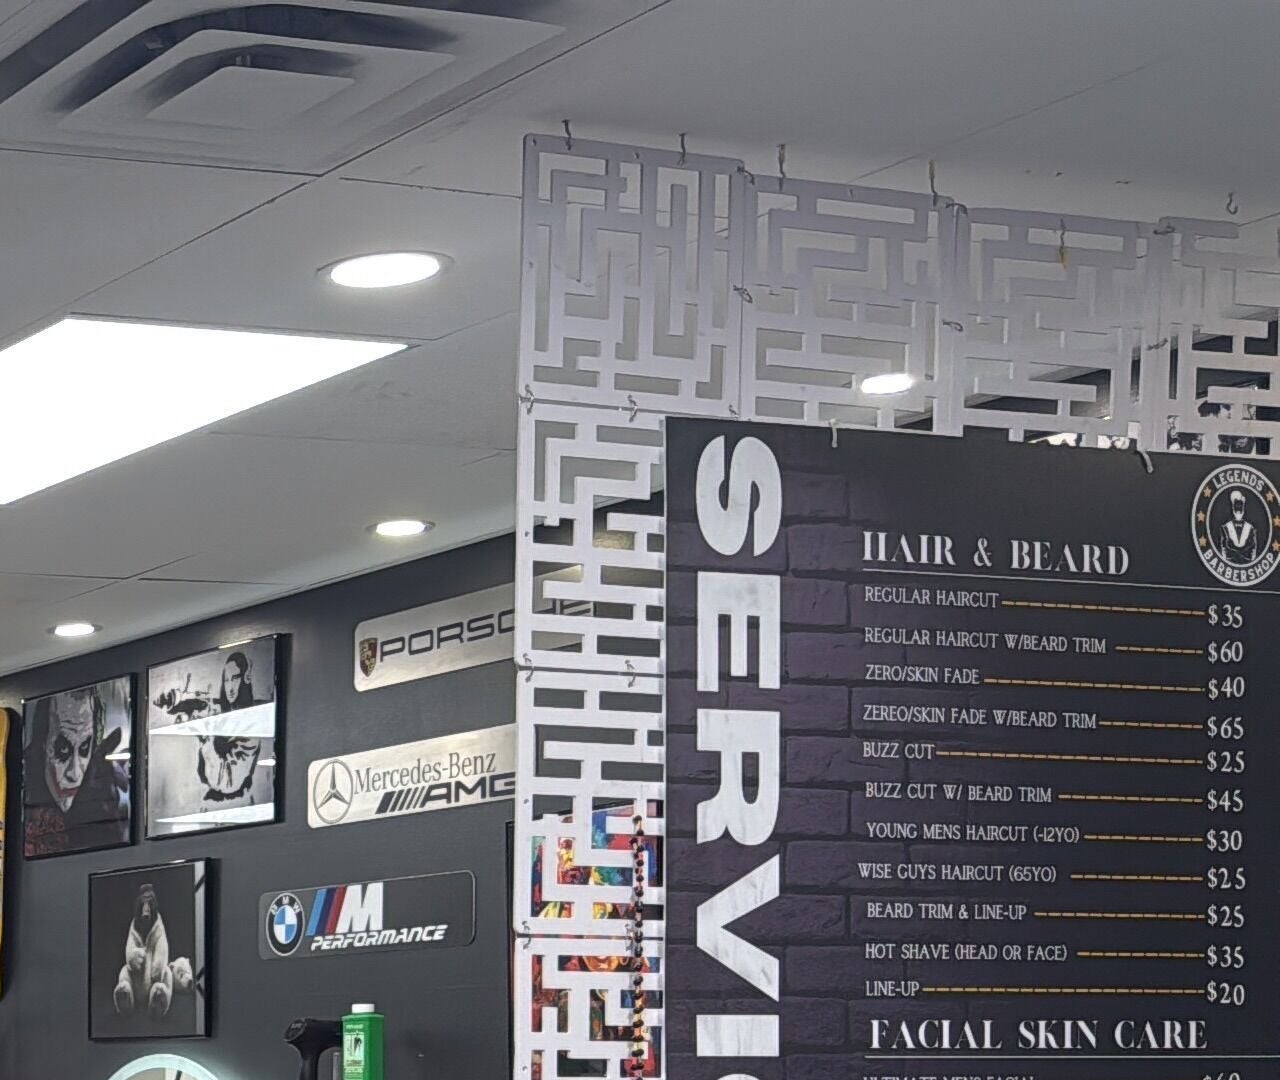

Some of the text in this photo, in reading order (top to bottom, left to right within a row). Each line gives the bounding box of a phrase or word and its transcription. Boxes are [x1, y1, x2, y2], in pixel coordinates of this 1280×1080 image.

[1212, 470, 1265, 492] LEGENDS
[862, 531, 1129, 575] HAIR & BEARD
[1203, 549, 1274, 582] BARBERSHOP
[864, 585, 1243, 629] REGULAR HAIRCUT $35
[864, 626, 1243, 664] REGULAR HAIRCUT W/BEARD TRIM $60
[864, 664, 1245, 701] ZERO/SKIN FADE $40
[862, 704, 1244, 740] ZEREO/SKIN FADE W/BEARD TRIM $65
[862, 741, 1245, 773] BUZZ CUT $25
[354, 752, 496, 795] Mercedes-Benz
[865, 781, 1244, 812] BUZZ CUT W/ BEARD TRIM $45
[866, 822, 918, 839] YOUNG
[922, 823, 961, 840] MENS
[966, 824, 1029, 842] HAIRCUT
[1206, 829, 1243, 852] $30
[857, 862, 1246, 890] WISE GUYS HAIRCUT (65YO) $25
[867, 902, 1245, 928] BEARD TRIM & LINE-UP $25
[310, 925, 448, 951] PERFORMANCE
[865, 942, 1244, 969] HOT SHAVE (HEAD OR FACE) $35
[865, 980, 1245, 1006] LINE-UP $20
[870, 1019, 1207, 1049] FACIAL SKIN CARE
